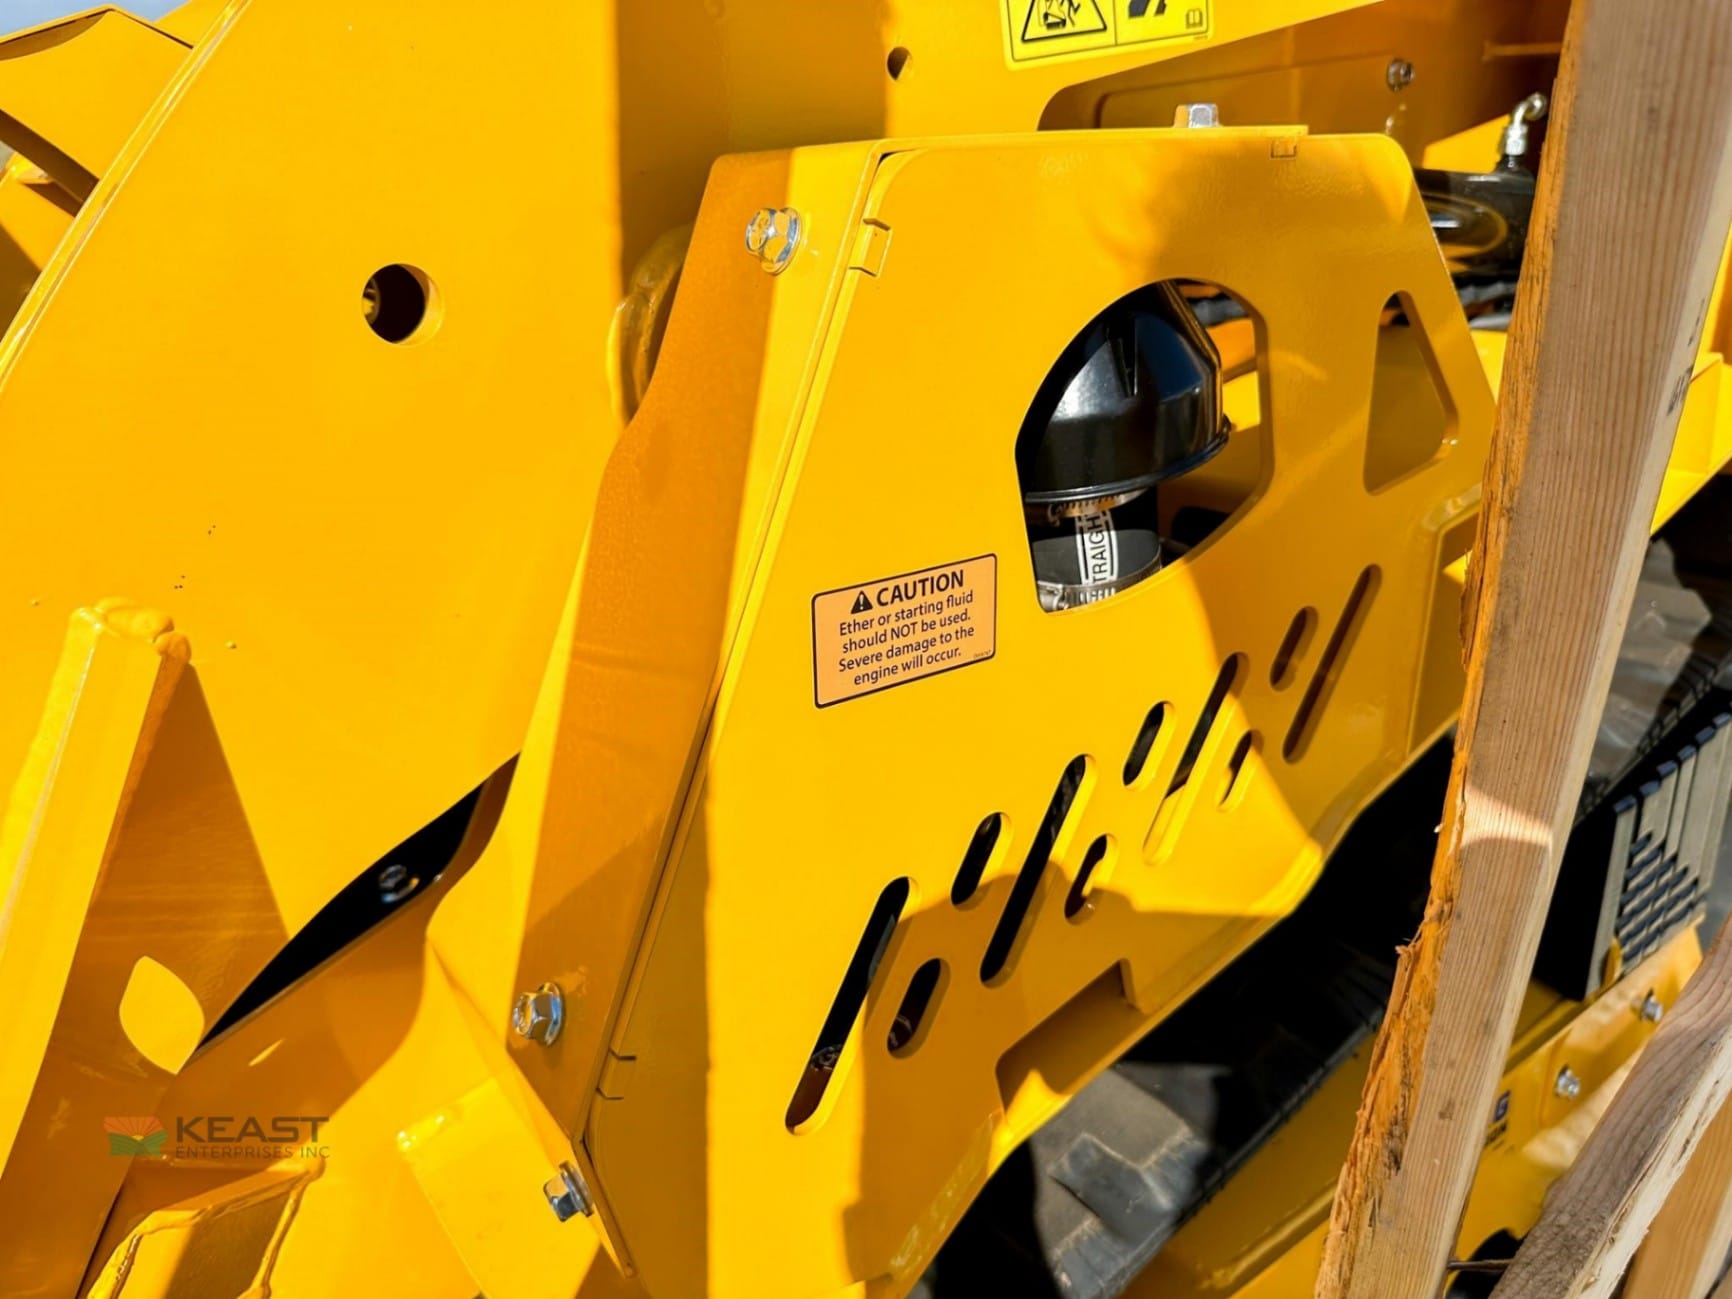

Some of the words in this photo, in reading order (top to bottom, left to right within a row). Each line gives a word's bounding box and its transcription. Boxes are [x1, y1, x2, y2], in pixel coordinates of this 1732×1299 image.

[876, 569, 964, 607] CAUTION
[840, 618, 874, 636] Ether
[878, 614, 891, 627] or
[895, 599, 943, 622] starting
[946, 589, 974, 609] fluid
[842, 629, 887, 654] should
[890, 621, 918, 641] NOT
[921, 617, 936, 633] be
[940, 608, 971, 627] used.
[839, 651, 883, 673] Severe
[886, 634, 937, 660] damage
[940, 631, 952, 645] to
[955, 624, 974, 641] the
[854, 662, 898, 686] engine
[901, 653, 923, 673] will
[926, 645, 961, 665] occur.
